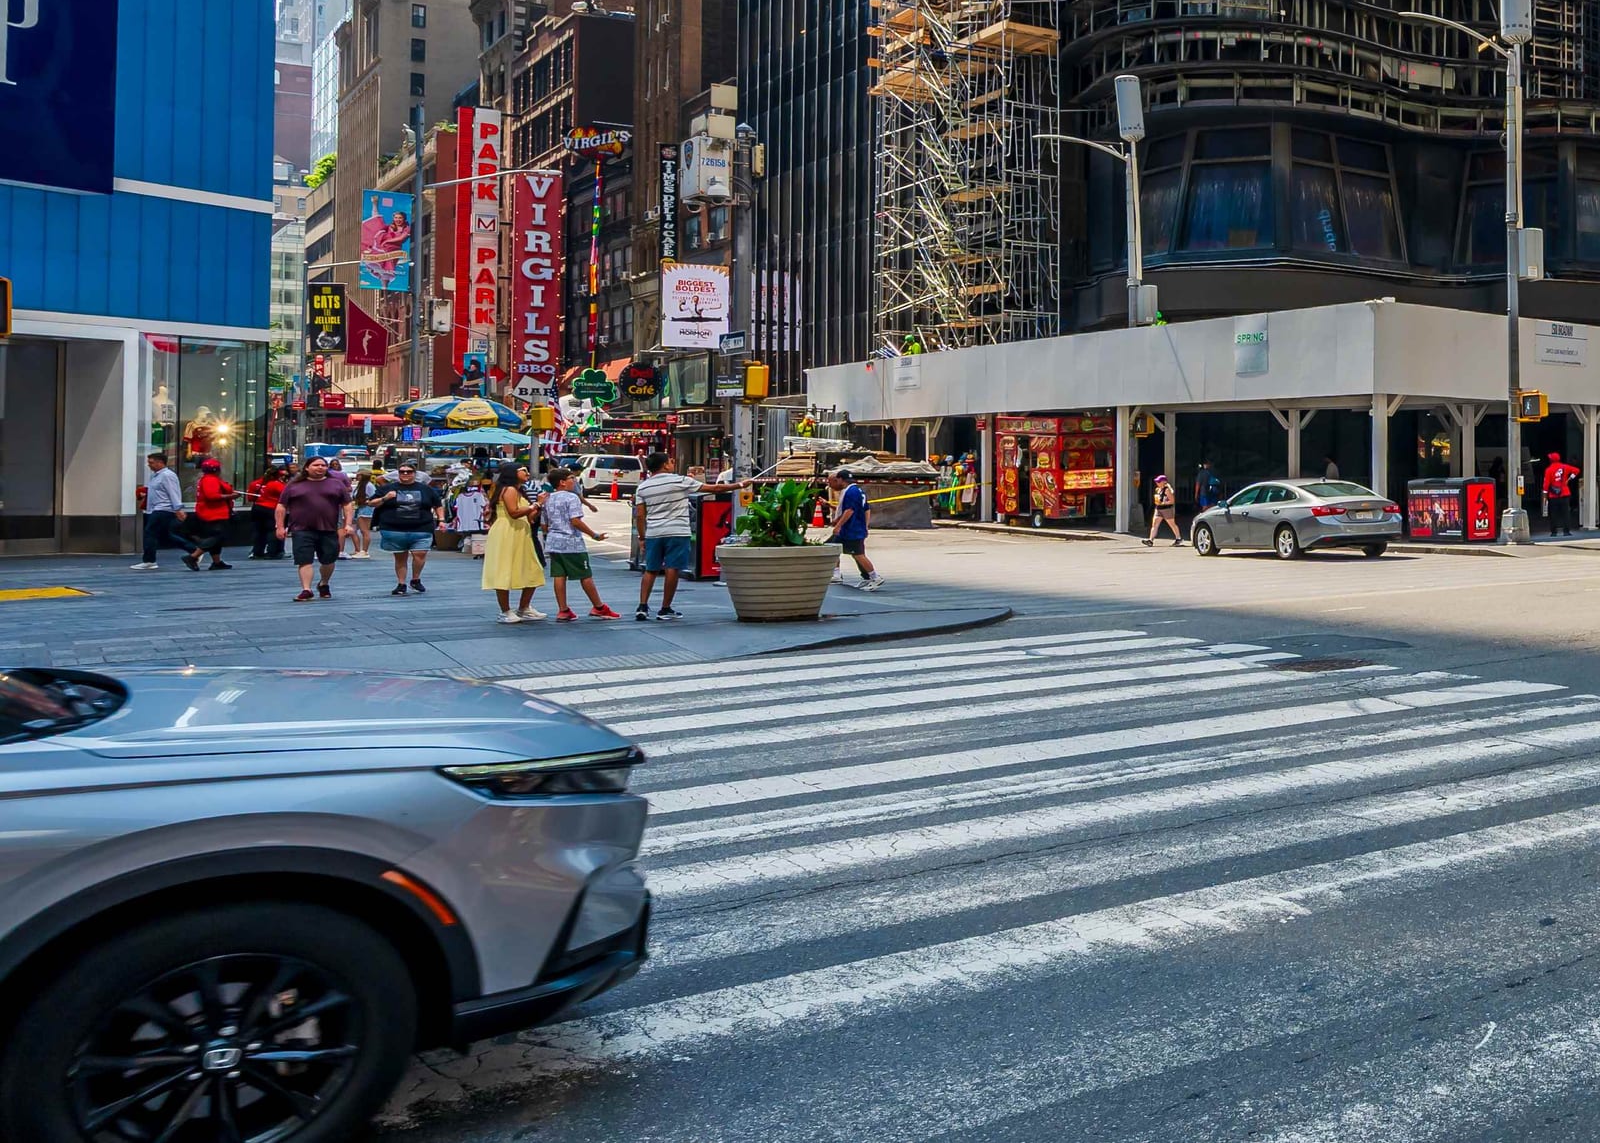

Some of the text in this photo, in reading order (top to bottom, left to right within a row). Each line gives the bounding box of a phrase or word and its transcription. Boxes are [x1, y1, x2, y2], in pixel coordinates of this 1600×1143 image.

[562, 130, 632, 150] VIRGIL'S
[475, 123, 499, 201] PARK
[701, 157, 727, 168] 726158
[662, 161, 676, 193] TIMES
[663, 195, 675, 221] DELI
[661, 231, 676, 257] CAFE
[474, 248, 497, 324] PARK
[313, 295, 341, 309] CATS
[1236, 332, 1265, 344] SPRNG
[518, 364, 556, 375] BBQ
[630, 368, 654, 379] Deli
[628, 384, 655, 395] Café
[1475, 518, 1489, 529] MJ
